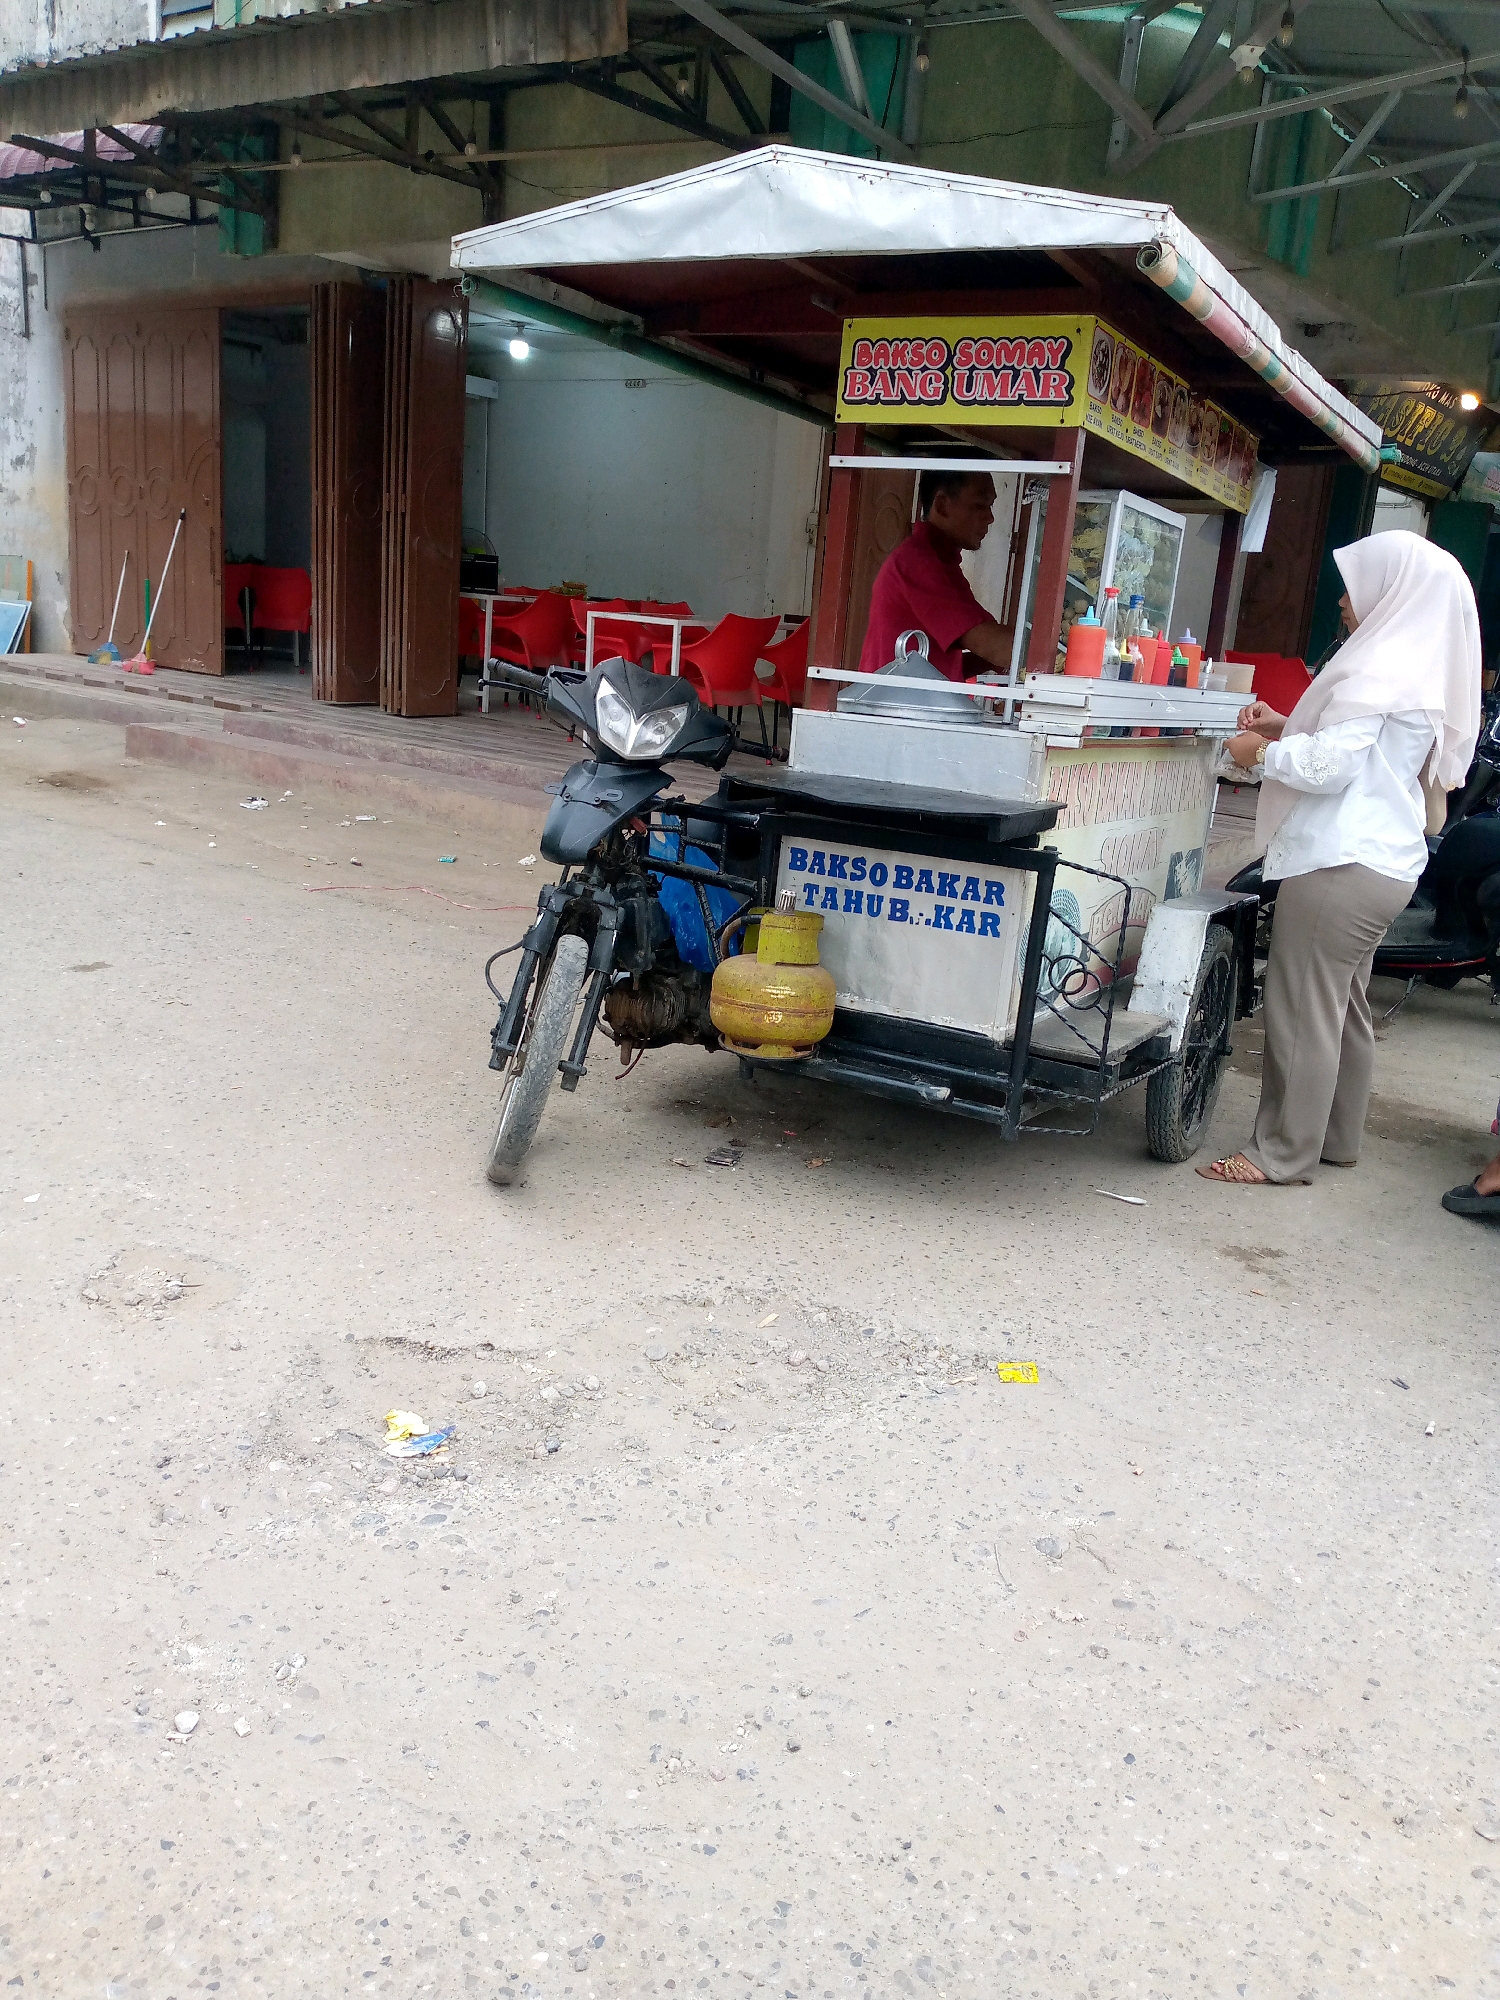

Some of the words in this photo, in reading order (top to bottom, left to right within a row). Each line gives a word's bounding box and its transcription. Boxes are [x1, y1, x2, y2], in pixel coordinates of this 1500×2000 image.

[854, 338, 948, 369] BAKSO
[953, 336, 1068, 369] SOMAY
[843, 368, 944, 401] BANG
[953, 369, 1070, 402] UMAR
[1437, 390, 1458, 409] MAS
[1089, 401, 1102, 415] BAKSO
[1111, 413, 1123, 427] BAKSO
[1047, 761, 1099, 832] BAKSO
[1094, 761, 1143, 825] BAKAR
[788, 846, 889, 887] BAKSO
[892, 865, 1005, 907] BAKAR
[803, 882, 884, 918] TAHU
